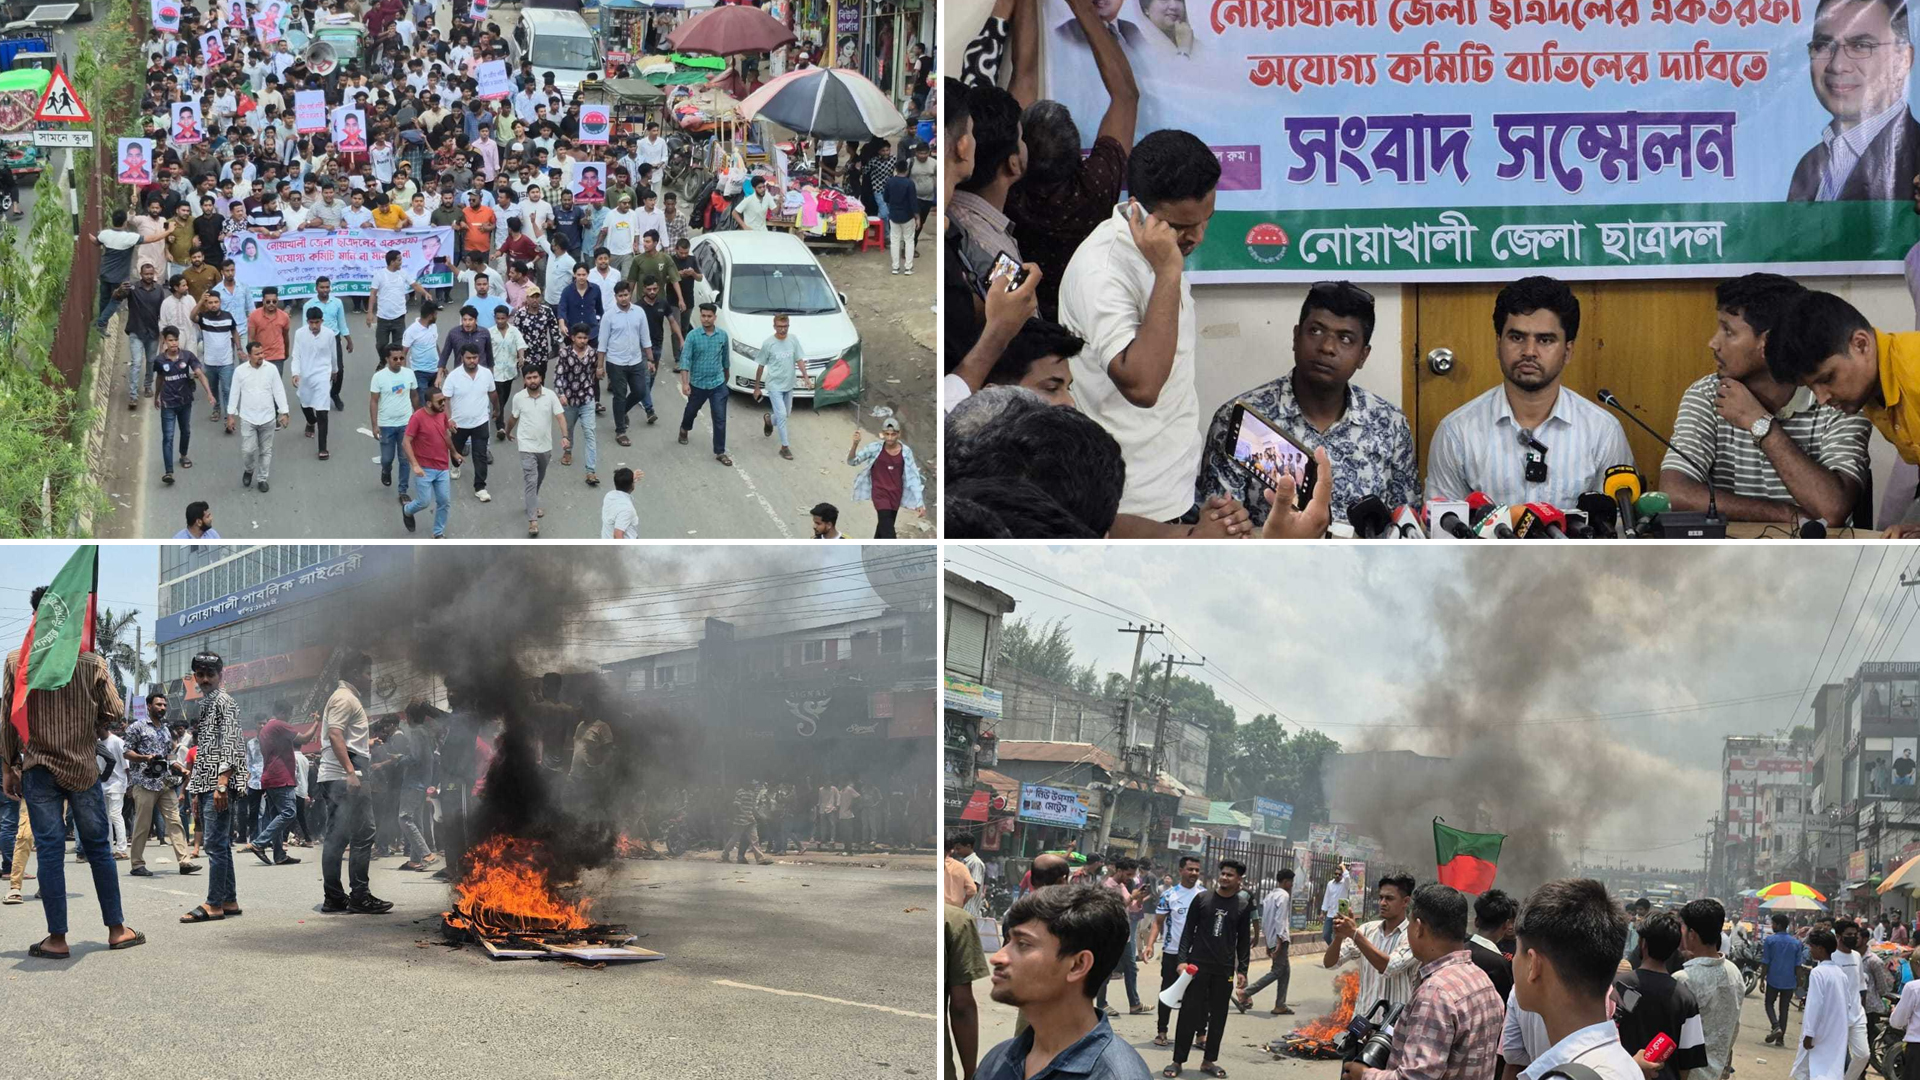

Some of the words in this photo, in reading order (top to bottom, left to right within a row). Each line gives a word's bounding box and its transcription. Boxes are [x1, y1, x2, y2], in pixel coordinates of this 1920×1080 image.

[1247, 54, 1377, 93] অযোগ্য
[1387, 41, 1494, 84] কমিটি
[1504, 40, 1650, 88] বাতিলের
[1658, 40, 1769, 88] দাবিতে
[38, 133, 68, 142] সামনে
[72, 134, 89, 145] স্কুল
[1284, 112, 1473, 186] সংবাদ
[1493, 110, 1737, 194] সম্মেলন
[267, 237, 306, 250] নোয়াখালী
[310, 238, 333, 247] জেলা
[337, 238, 376, 248] ছাত্রদলের
[1299, 210, 1479, 265] নোয়াখালী
[1491, 219, 1586, 261] জেলা
[1596, 218, 1728, 263] ছাত্রদল
[275, 253, 305, 264] অযোগ্য
[309, 250, 334, 261] কমিটি
[339, 249, 356, 260] মানি
[359, 252, 368, 261] না
[187, 596, 239, 624] নোয়াখালী
[242, 578, 295, 606] পাবলিক
[299, 553, 364, 586] লাইব্রেরী
[1863, 663, 1882, 673] RUP
[789, 689, 828, 698] SIGNAL
